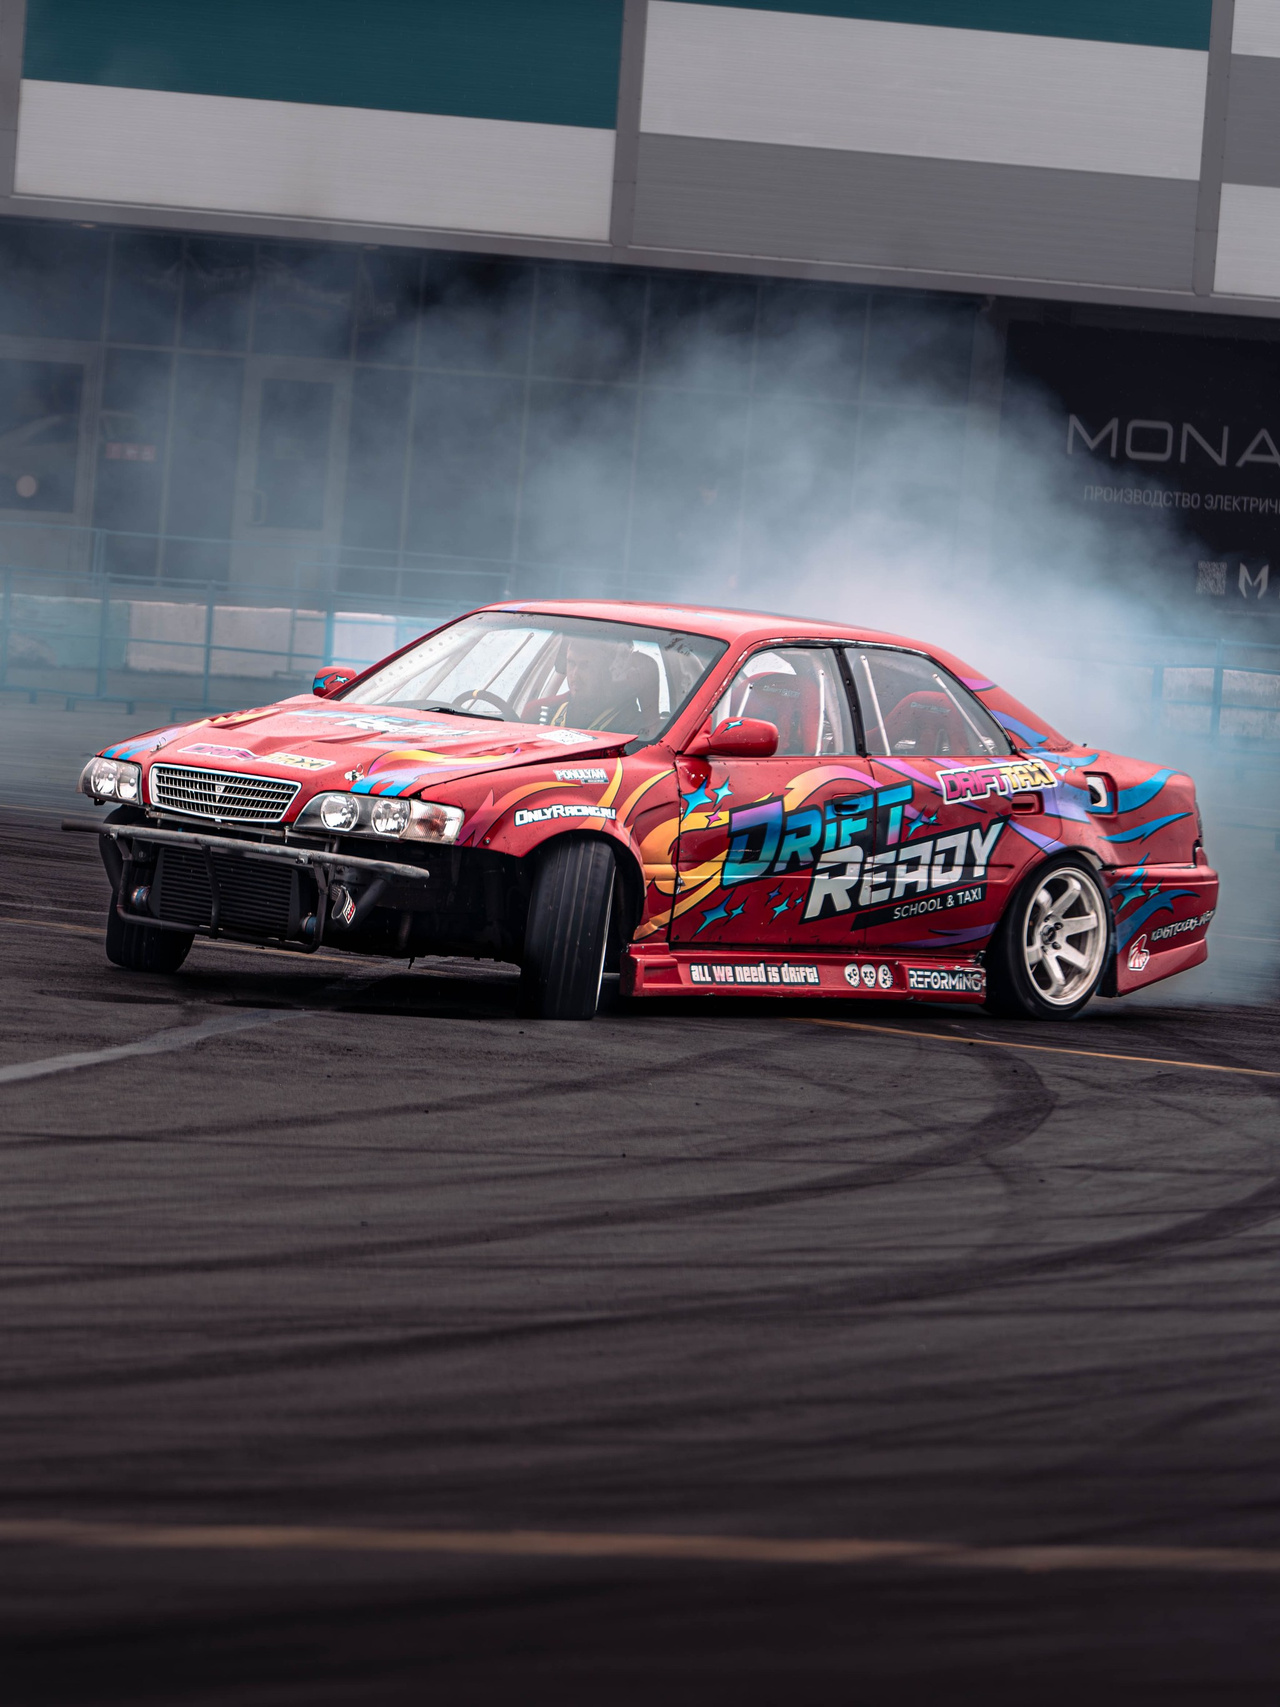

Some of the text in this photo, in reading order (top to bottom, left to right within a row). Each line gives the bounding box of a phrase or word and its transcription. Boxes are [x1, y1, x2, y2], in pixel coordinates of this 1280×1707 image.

[1066, 413, 1280, 468] MONA
[1084, 485, 1280, 515] ПРОИЗВОДСТВО ЭЛЕКТРИЧ
[722, 783, 914, 887] DRIFT
[804, 820, 1008, 919] READY
[893, 887, 982, 920] SCHOOL & TAXI
[712, 965, 734, 982] we
[735, 963, 767, 983] need
[767, 966, 781, 983] is
